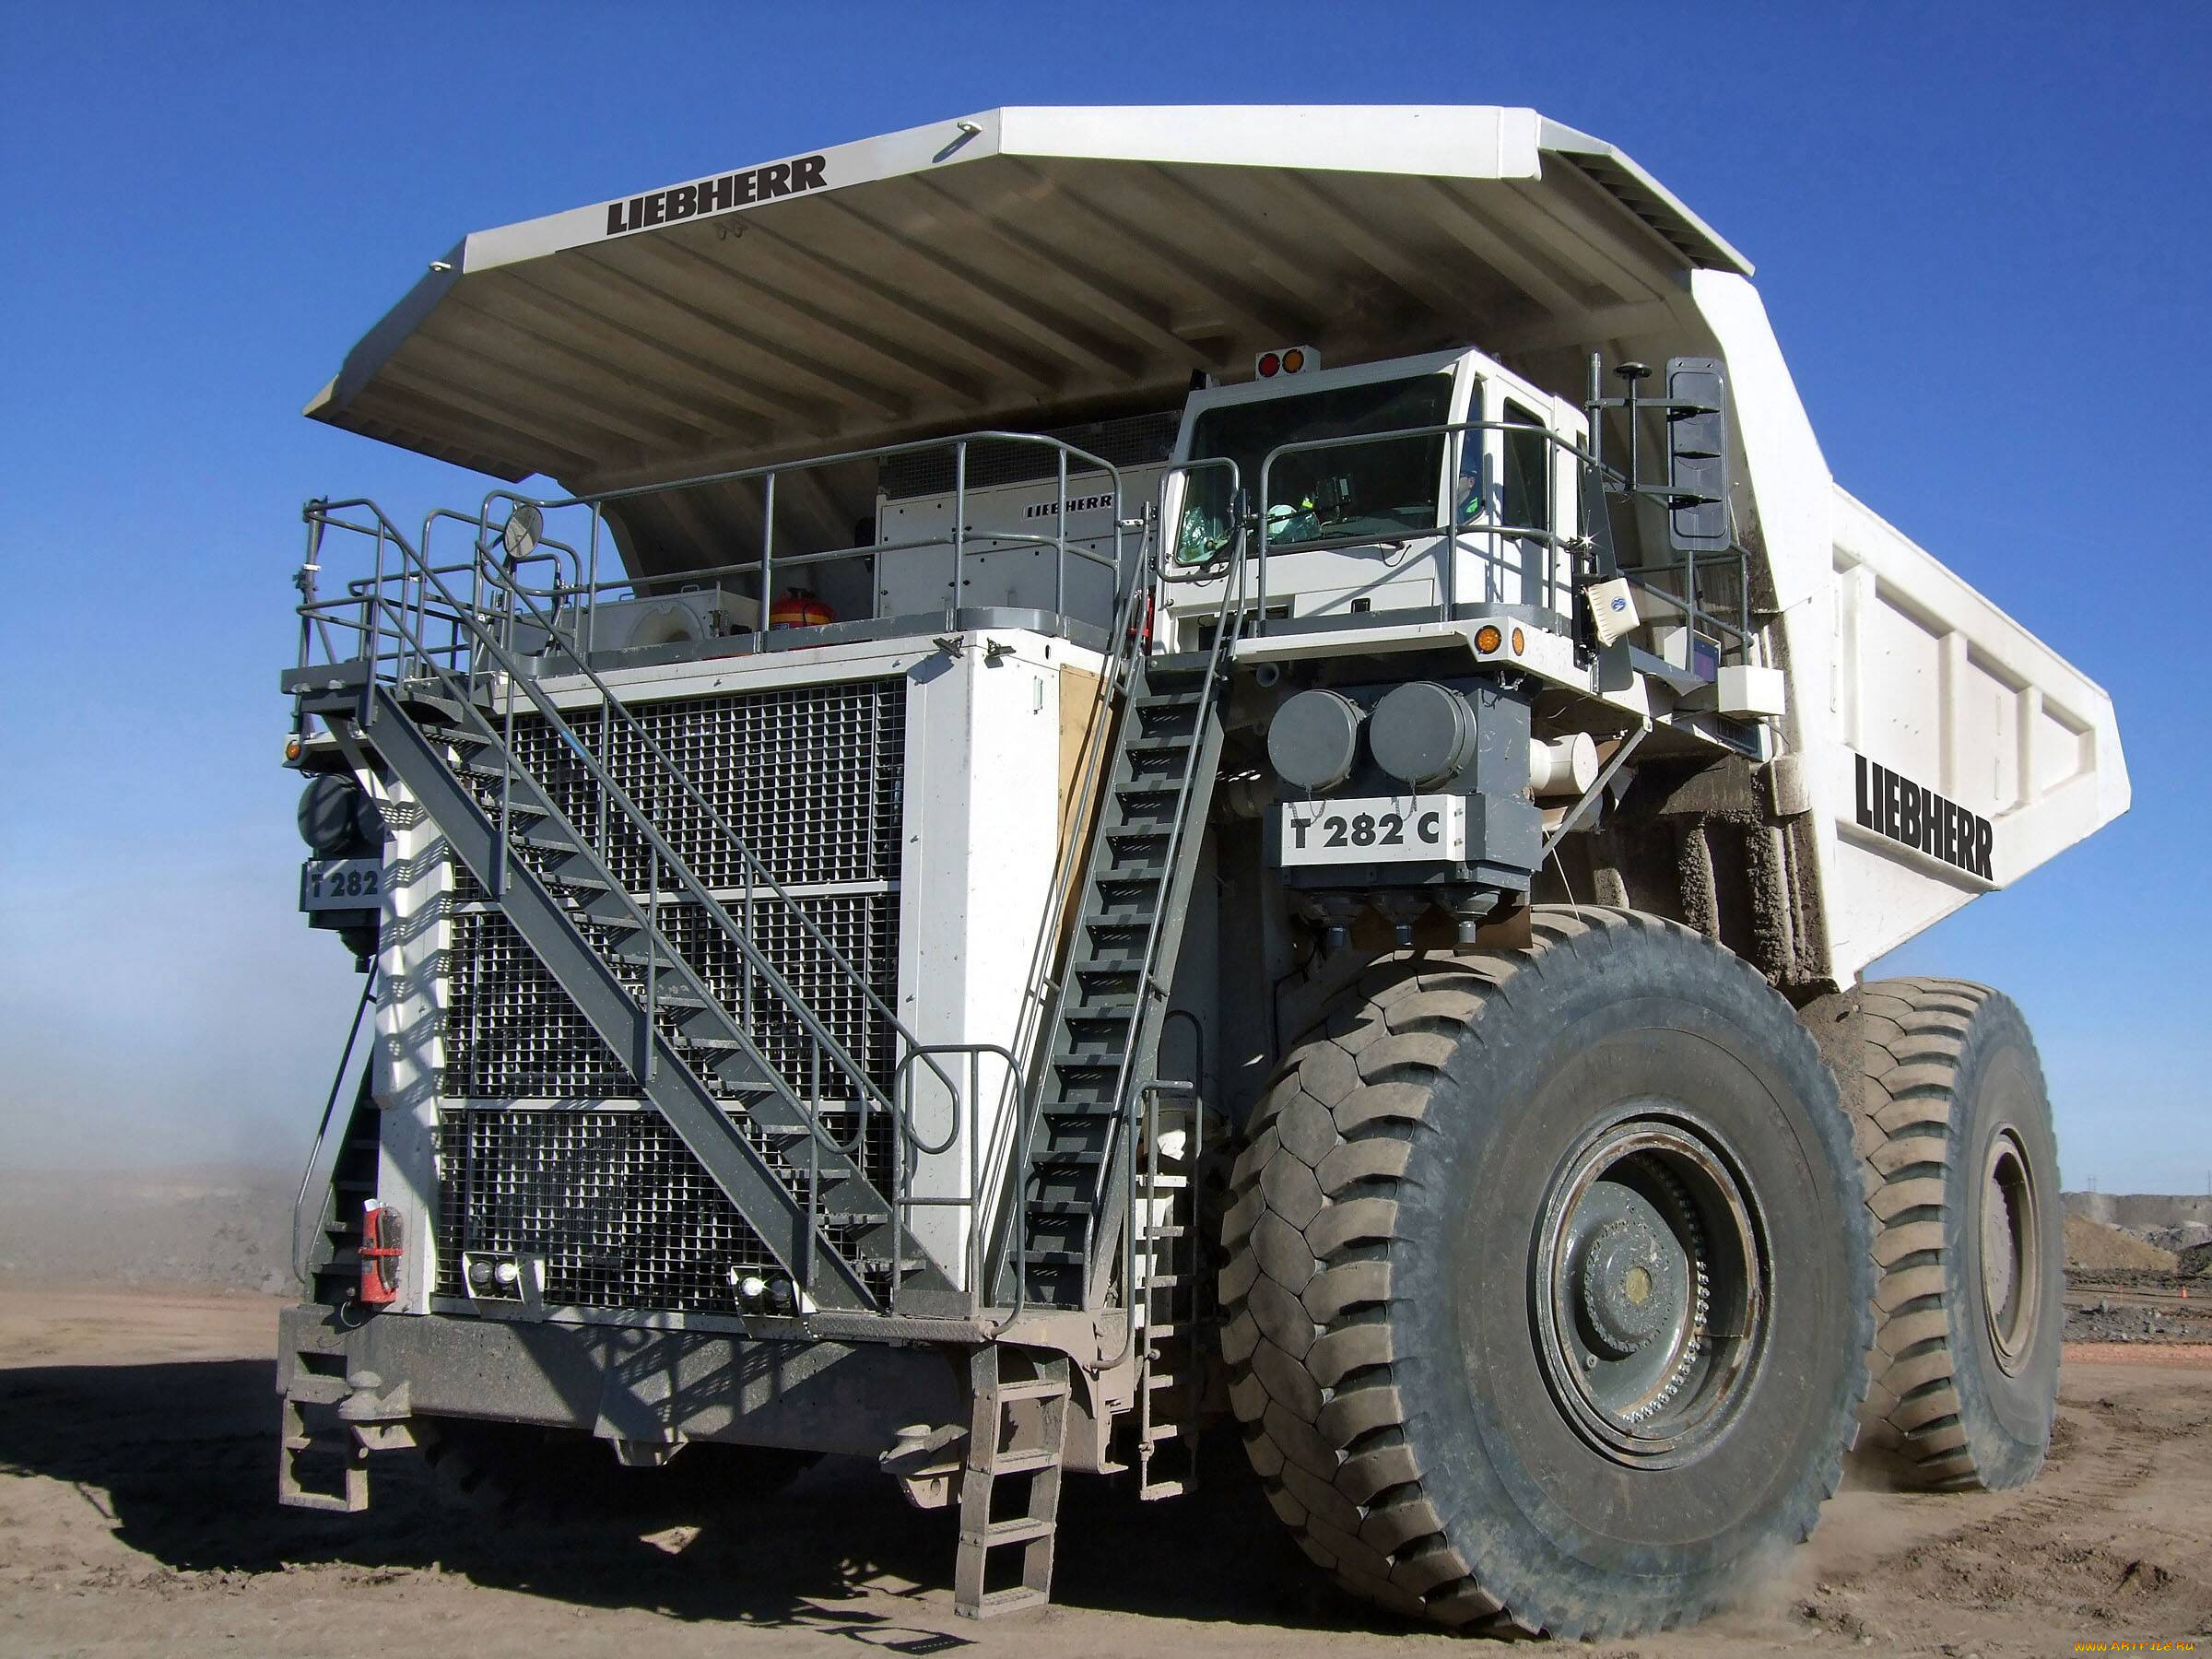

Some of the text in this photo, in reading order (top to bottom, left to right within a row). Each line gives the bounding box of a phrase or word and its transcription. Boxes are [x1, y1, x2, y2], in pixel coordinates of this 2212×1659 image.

[606, 155, 828, 236] LIEBHERR
[1026, 495, 1113, 517] LIEBHERR
[1290, 811, 1440, 849] T 282 C
[1854, 752, 1994, 882] LIEBHERR
[312, 869, 378, 898] T 282
